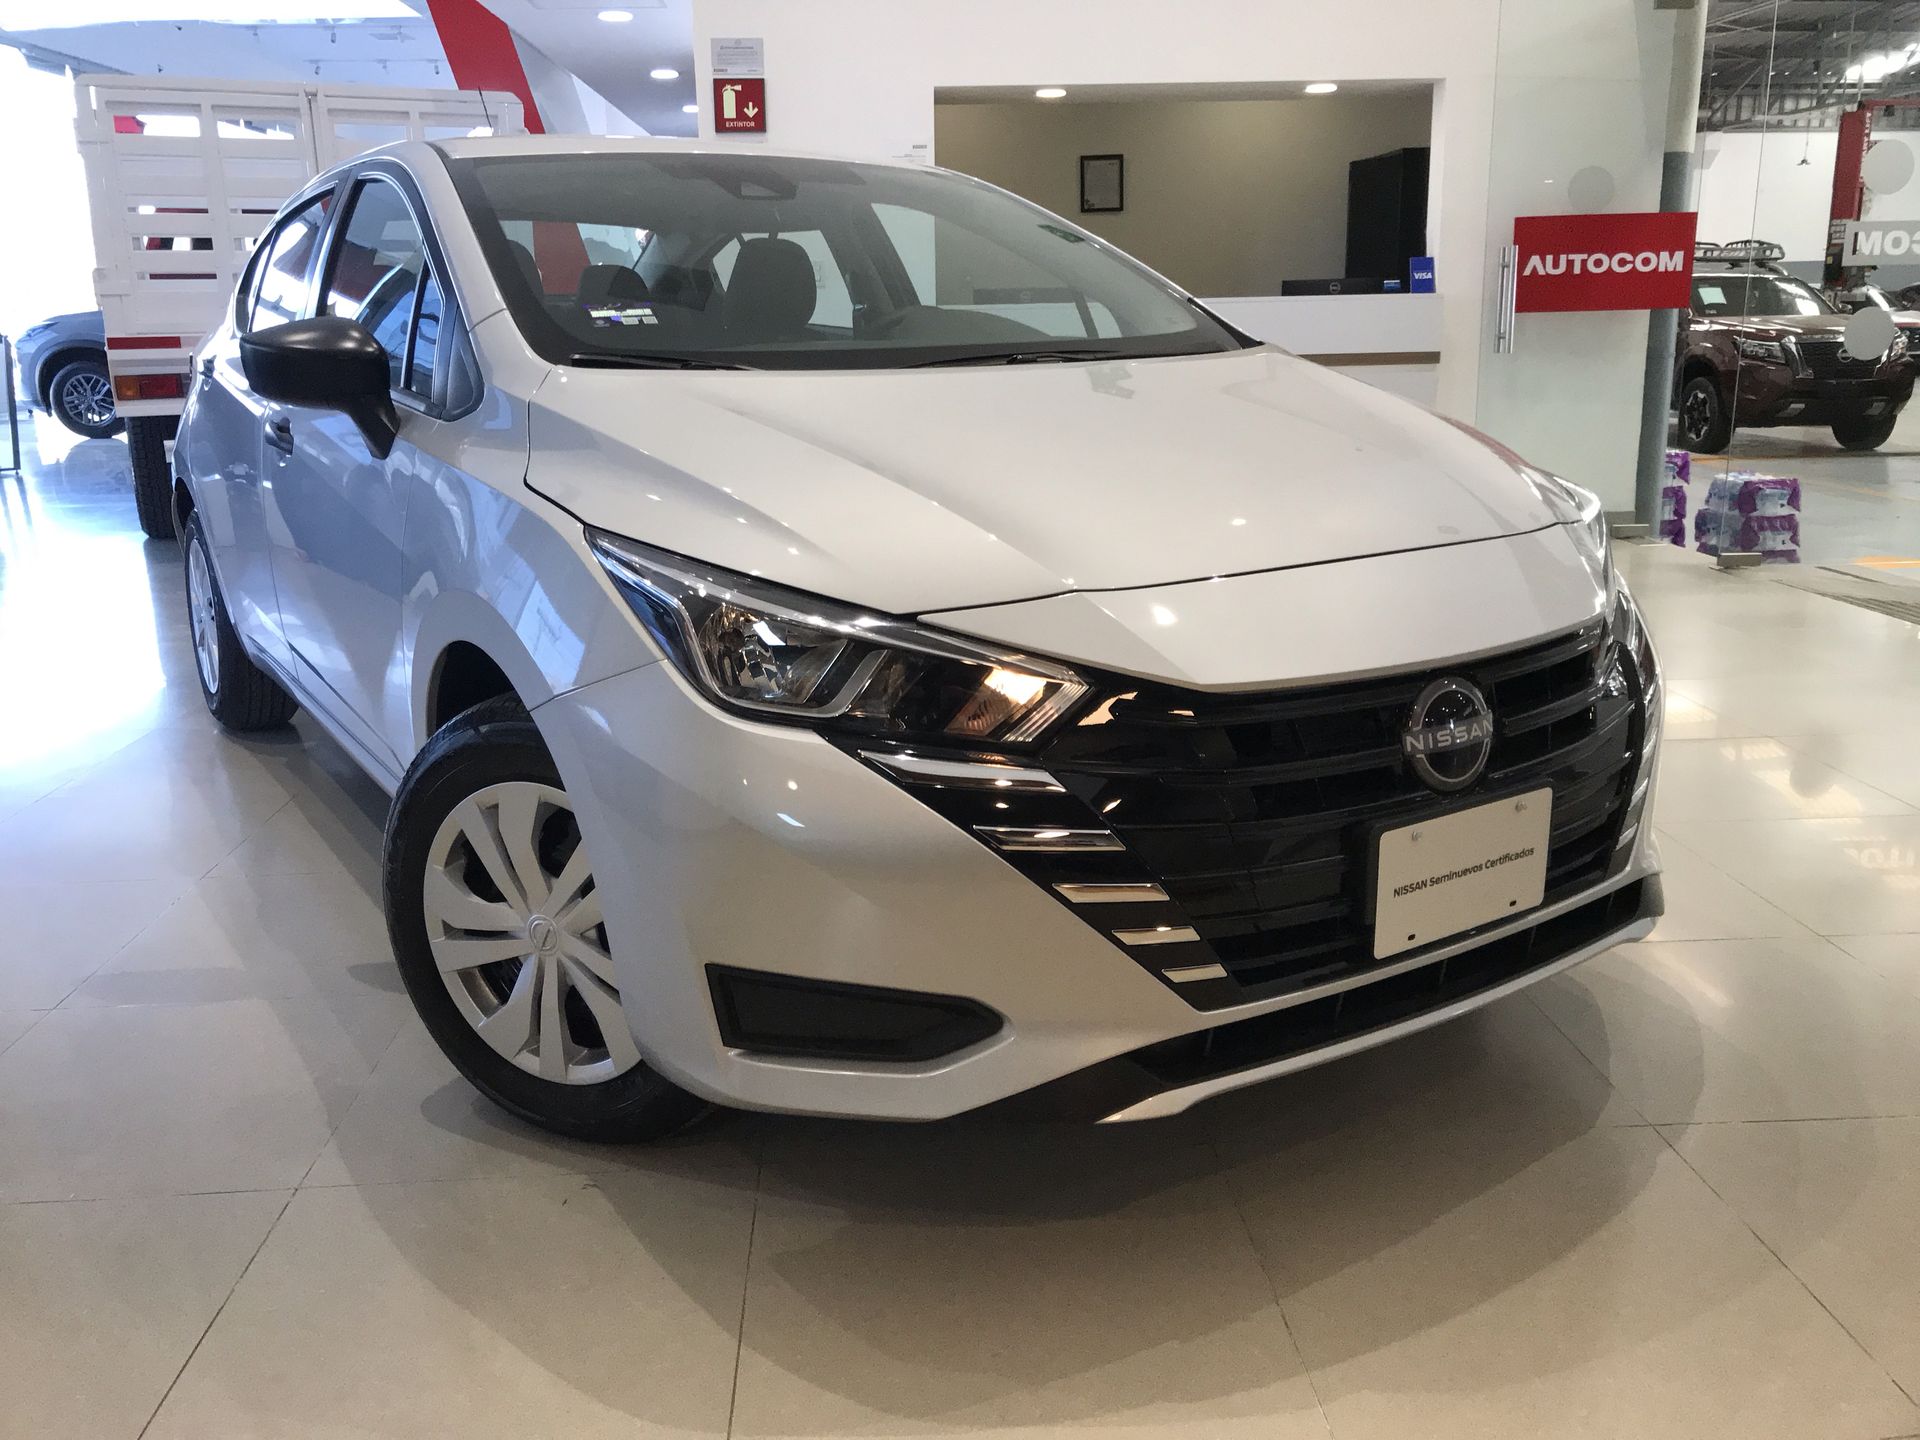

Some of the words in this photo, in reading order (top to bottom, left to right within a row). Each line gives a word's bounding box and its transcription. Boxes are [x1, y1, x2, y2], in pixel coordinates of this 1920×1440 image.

[1522, 250, 1685, 276] AUTOCOM
[1405, 719, 1493, 752] NISSAN
[1393, 878, 1428, 898] NISSAN
[1428, 863, 1483, 887] Seminuevos
[1484, 847, 1535, 870] Certificados
